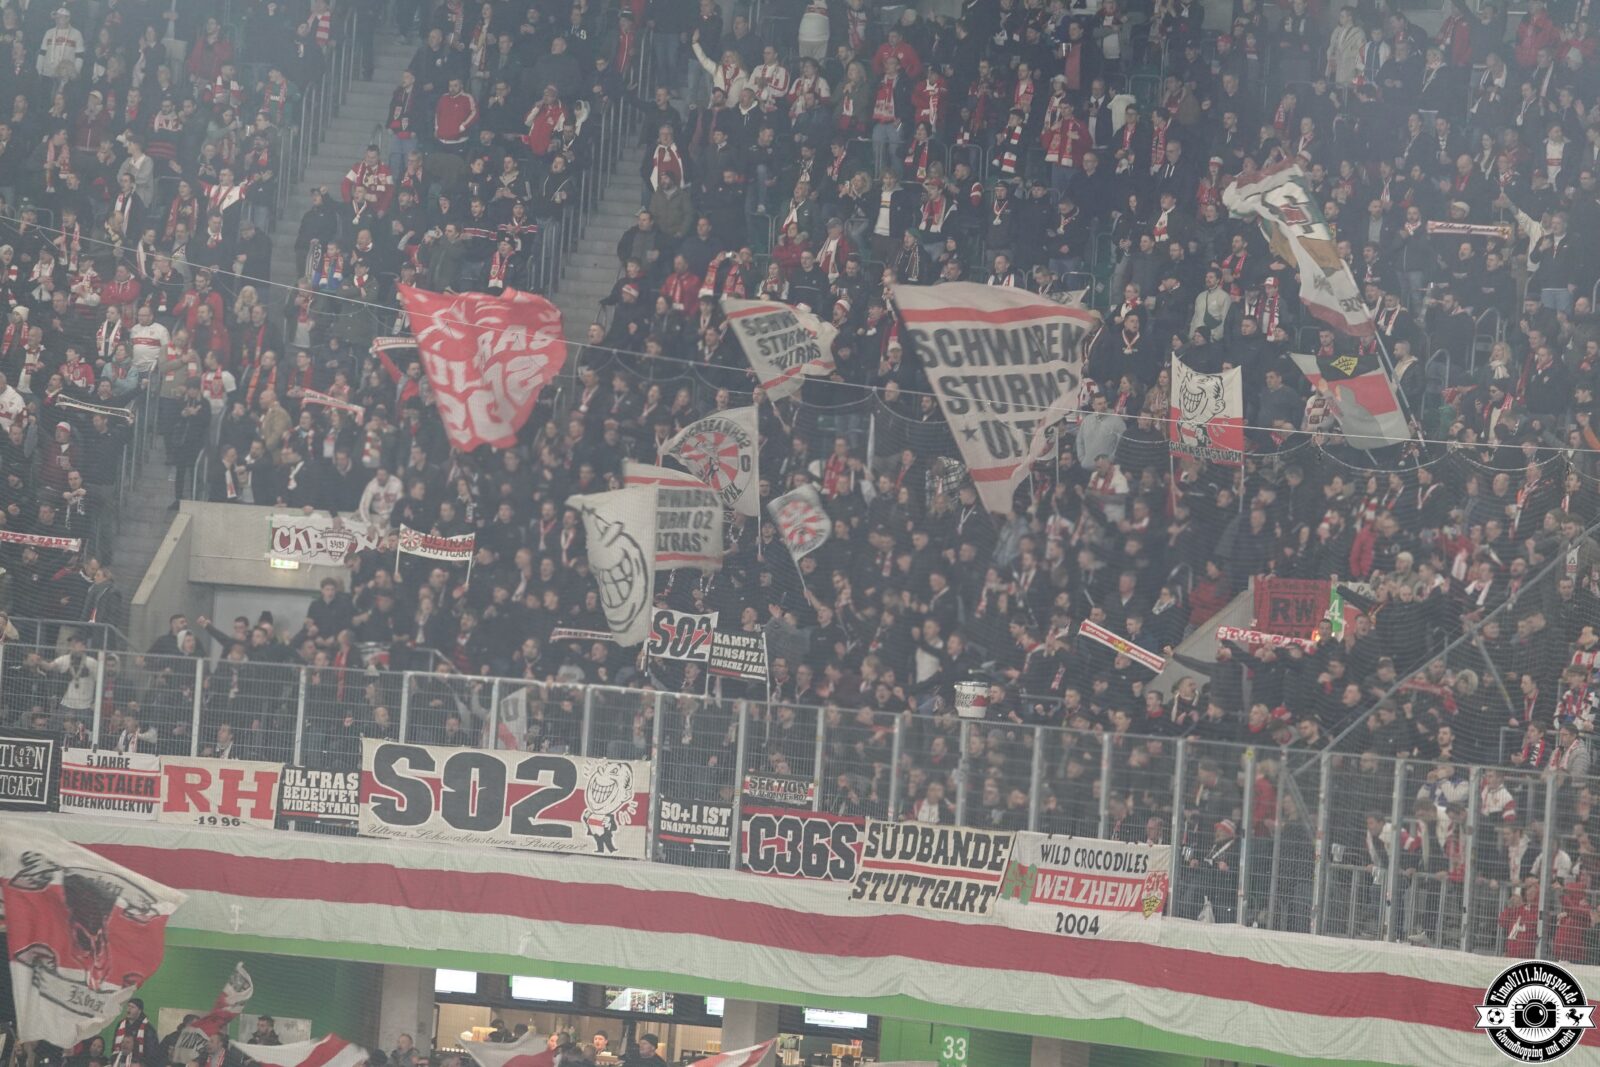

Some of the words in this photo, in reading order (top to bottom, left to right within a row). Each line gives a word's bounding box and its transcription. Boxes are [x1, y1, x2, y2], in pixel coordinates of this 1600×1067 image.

[713, 632, 757, 649] KAMPF
[710, 658, 743, 672] UNSERE
[712, 645, 758, 664] EINSATZ
[86, 754, 94, 767] 5
[96, 755, 131, 769] JAHRE
[63, 769, 155, 796] REMSTALER
[283, 768, 359, 790] ULTRAS
[749, 776, 810, 795] SEKTION
[163, 764, 279, 820] RH
[282, 785, 359, 803] BEDEUTET
[281, 798, 359, 816] WIDERSTAND
[661, 801, 698, 822] 50+1
[702, 805, 731, 825] IST
[367, 824, 408, 839] Ultras
[520, 836, 588, 851] Stuttgart
[660, 820, 729, 838] UNANTASTBAR!
[864, 822, 1010, 871] SÜDBANDE
[1040, 843, 1070, 865] WILD
[1073, 847, 1149, 874] CROCODILES
[852, 870, 996, 914] STUTTGART
[1034, 869, 1144, 908] WELZHEIM
[1054, 911, 1099, 936] 2004
[943, 1035, 967, 1061] 33
